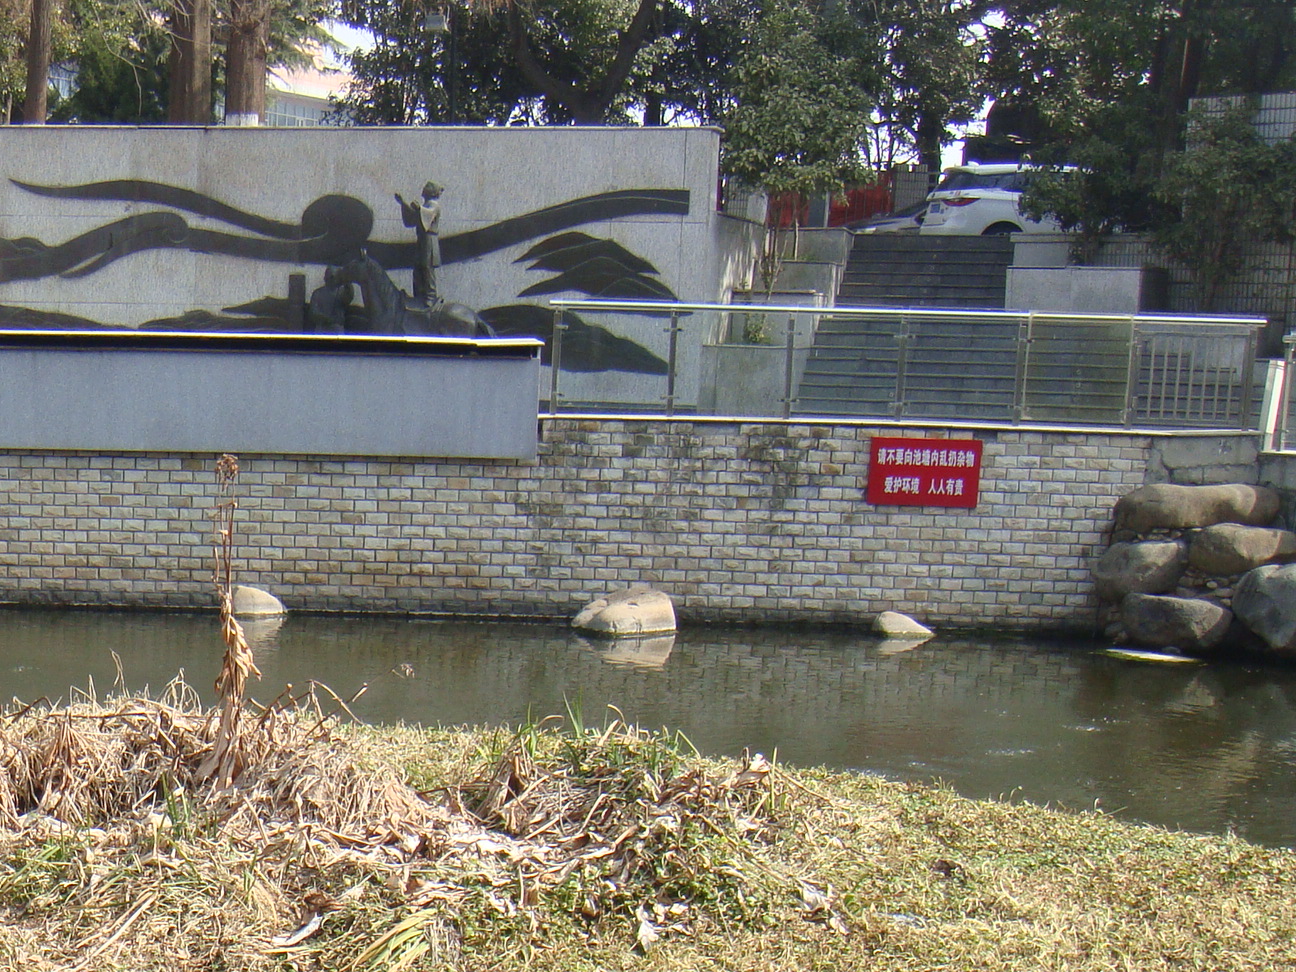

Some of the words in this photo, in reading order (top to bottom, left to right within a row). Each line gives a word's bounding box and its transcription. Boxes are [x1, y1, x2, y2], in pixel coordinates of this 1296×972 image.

[877, 448, 975, 468] 请不要向池塘内乱扔杂物
[884, 476, 920, 494] 爱护环境
[927, 478, 964, 495] 人人有责
